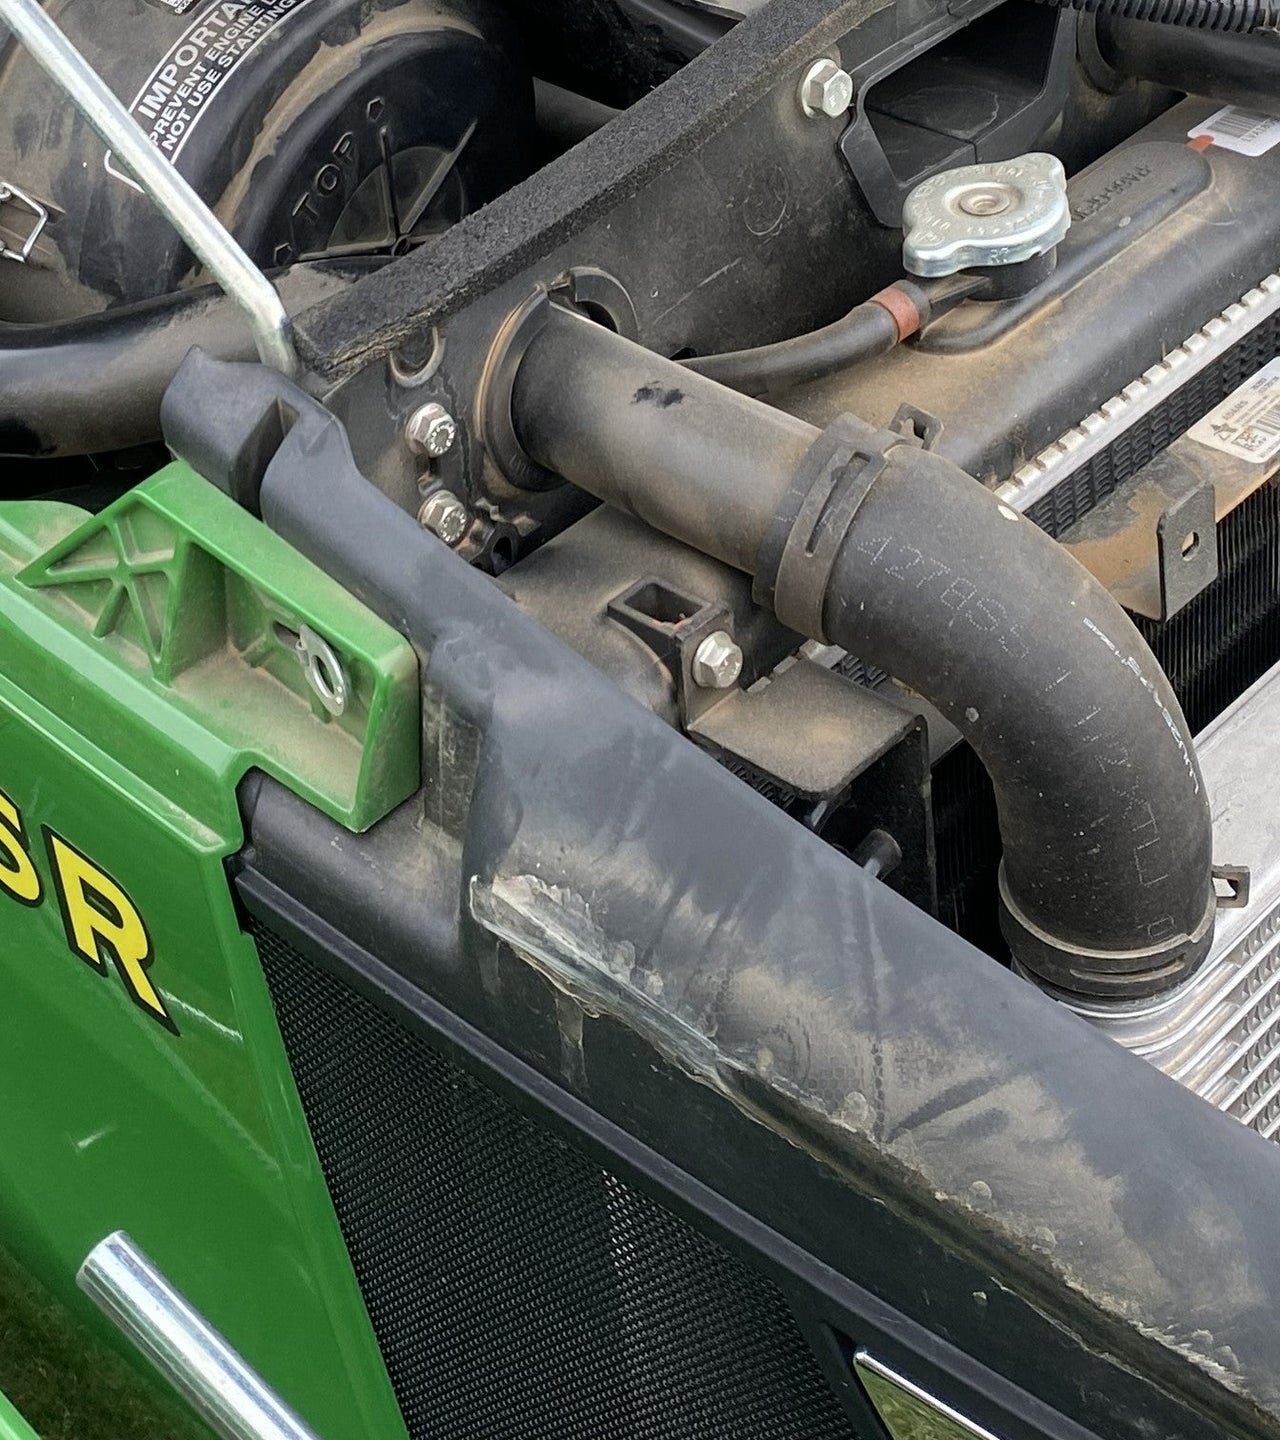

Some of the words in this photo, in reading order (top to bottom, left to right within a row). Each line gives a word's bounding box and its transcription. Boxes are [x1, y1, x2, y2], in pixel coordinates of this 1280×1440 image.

[149, 64, 210, 146] PREVENT
[206, 3, 265, 65] ENGINE
[162, 115, 190, 151] NOT
[189, 69, 222, 113] USE
[292, 131, 356, 225] TOP
